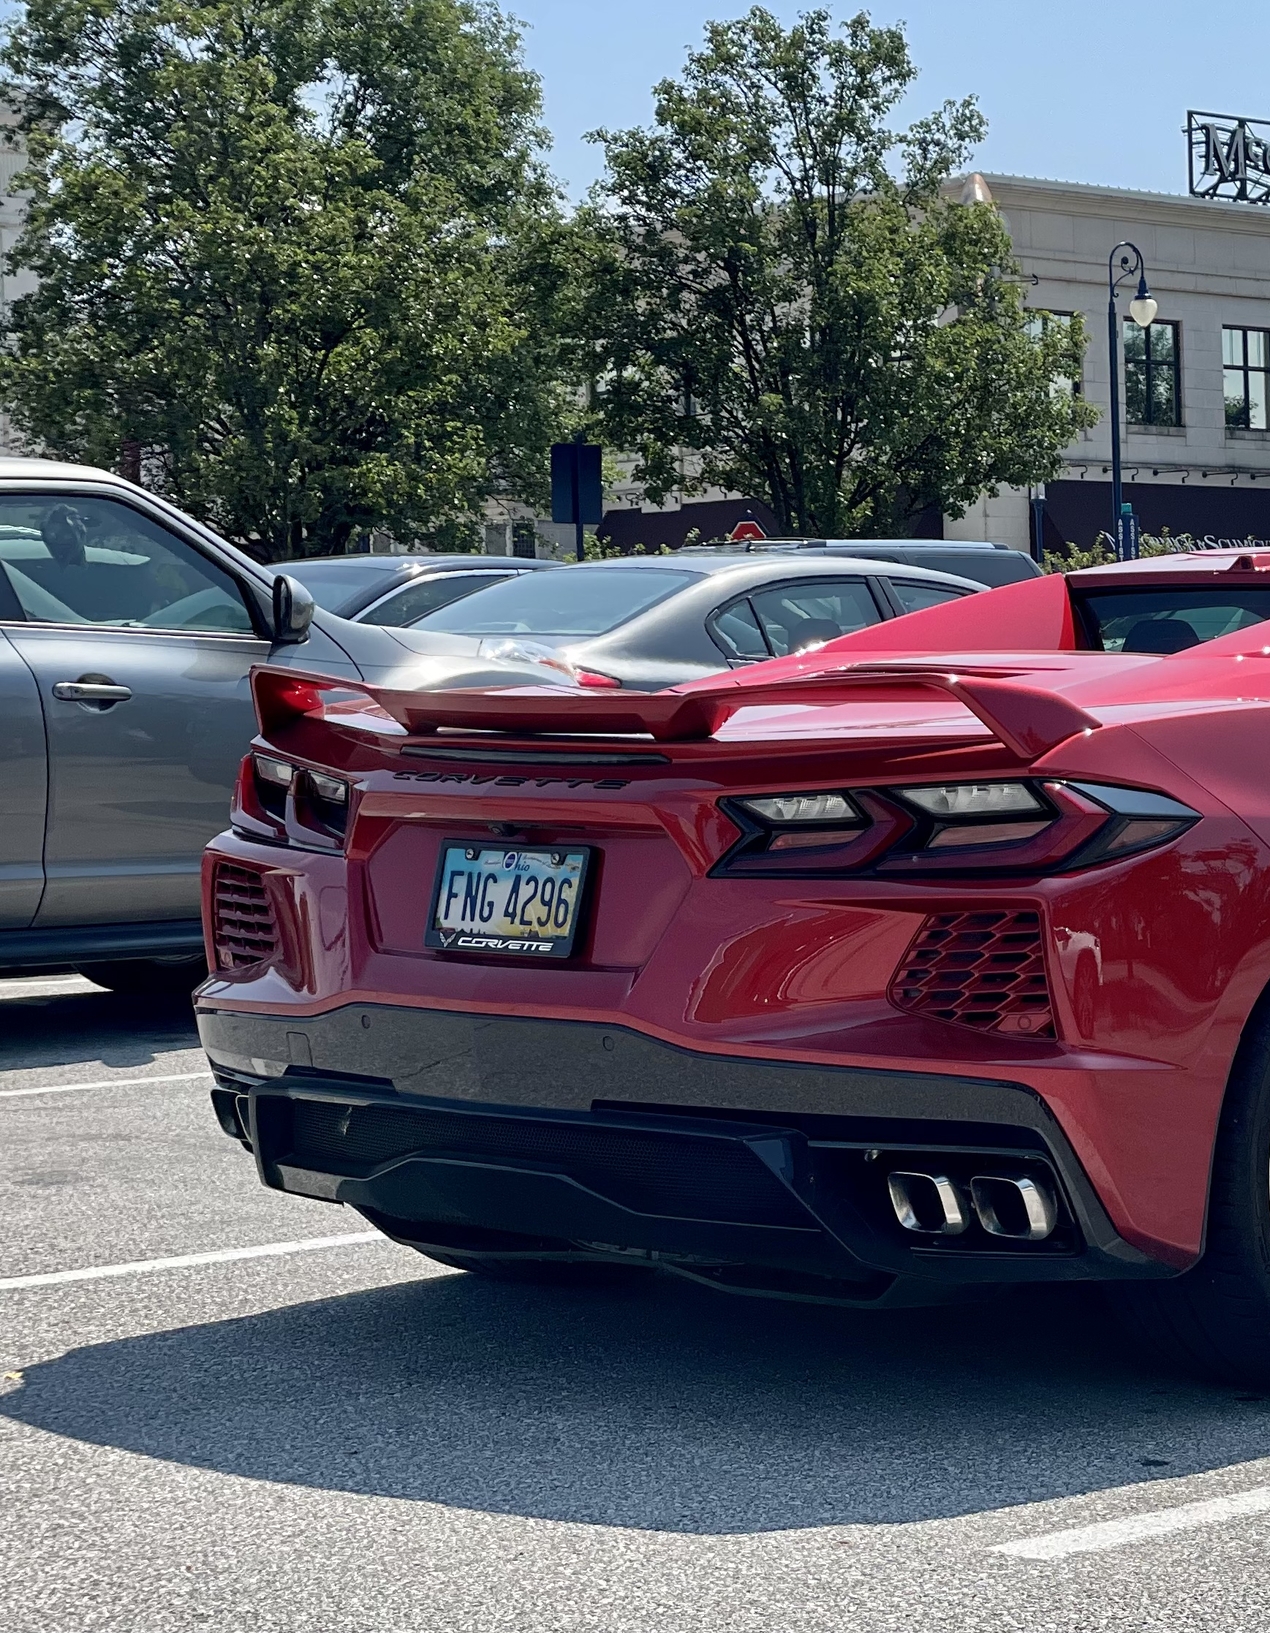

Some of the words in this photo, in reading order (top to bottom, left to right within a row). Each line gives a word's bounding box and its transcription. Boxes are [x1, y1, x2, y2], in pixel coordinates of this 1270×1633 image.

[393, 770, 631, 790] CORVETTE
[443, 870, 498, 923] FNG
[503, 874, 573, 929] 4296
[457, 936, 554, 952] CORVETTE
